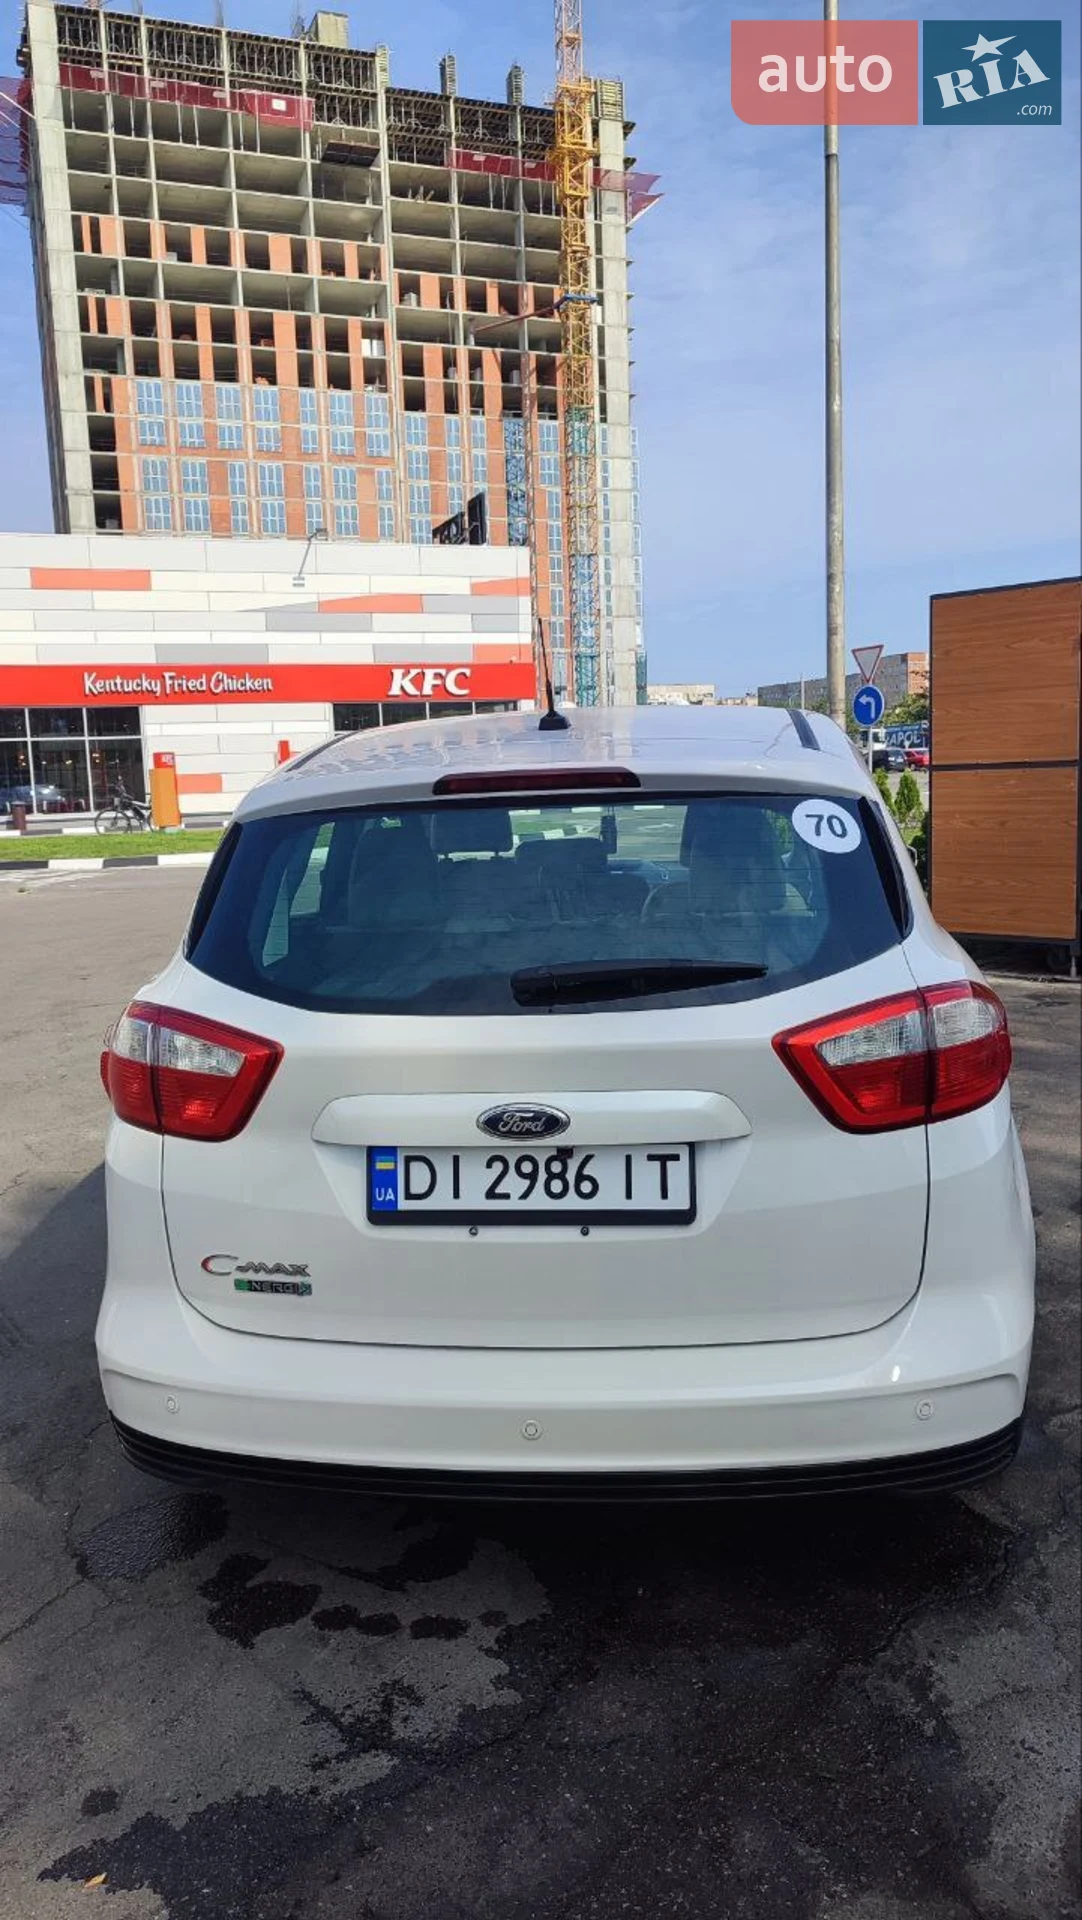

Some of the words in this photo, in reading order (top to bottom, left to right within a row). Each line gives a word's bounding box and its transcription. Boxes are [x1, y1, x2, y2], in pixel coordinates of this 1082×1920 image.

[84, 671, 161, 697] Kentucky
[162, 671, 207, 694] Fried
[210, 671, 273, 693] Chicken
[387, 668, 471, 696] KFC
[805, 814, 848, 838] 70
[498, 1112, 546, 1132] Ford
[404, 1155, 460, 1200] DI
[485, 1154, 599, 1200] 2986
[625, 1154, 680, 1200] IT
[376, 1188, 395, 1200] UA
[201, 1254, 311, 1277] C-MAX
